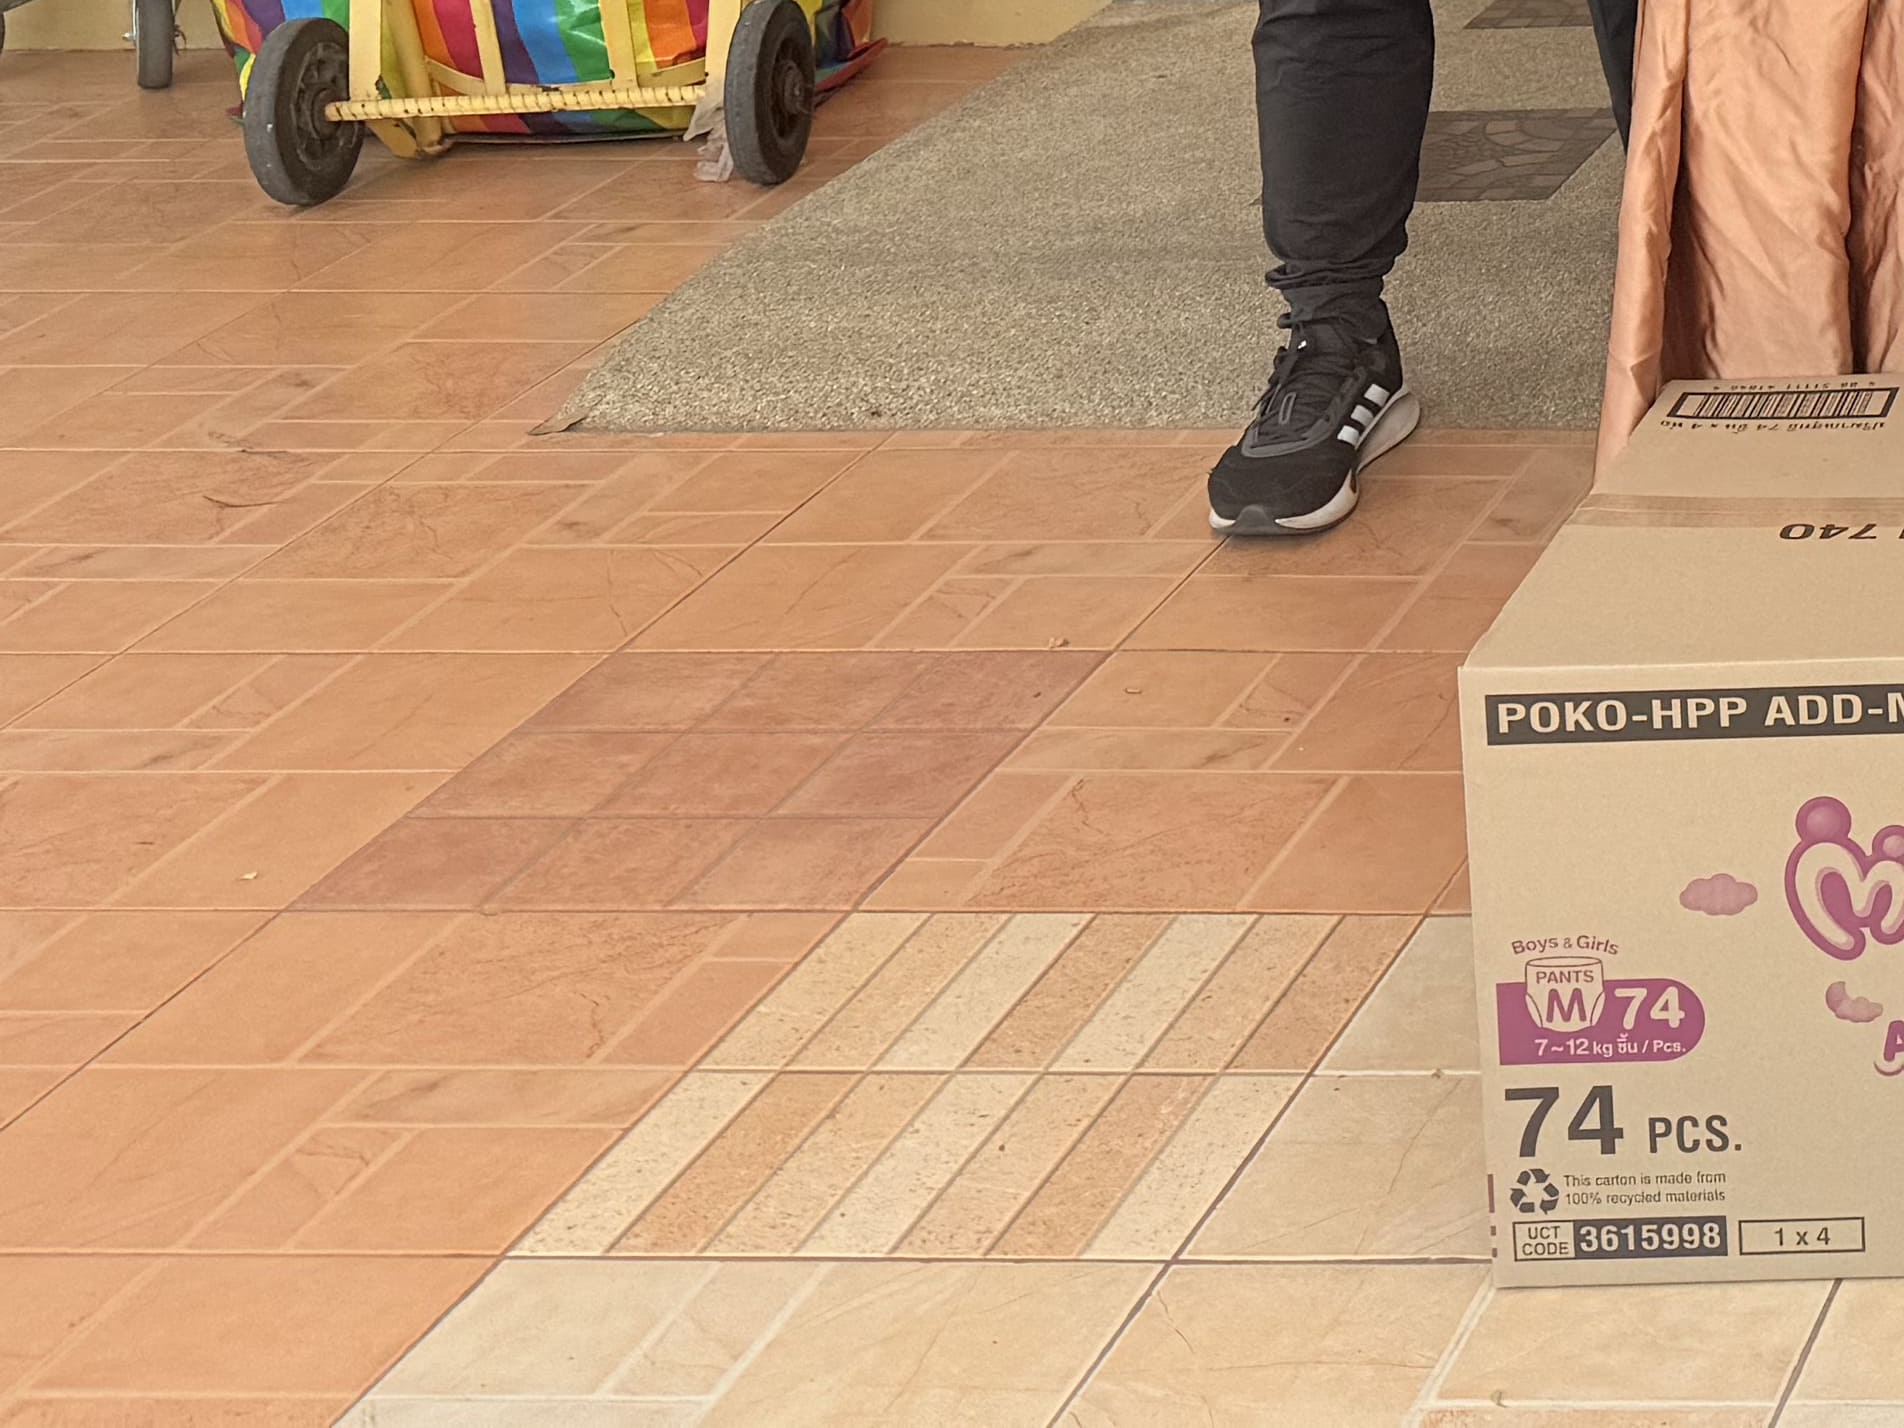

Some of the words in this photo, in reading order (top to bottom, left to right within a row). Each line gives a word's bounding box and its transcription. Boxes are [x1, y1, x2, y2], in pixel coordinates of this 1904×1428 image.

[1496, 696, 1747, 736] POKO-HPP
[1536, 970, 1594, 985] PANTS
[1546, 988, 1587, 1023] M
[1614, 986, 1685, 1030] 74
[1505, 1085, 1624, 1158] 74
[1649, 1115, 1742, 1153] PCS.
[1522, 1242, 1569, 1256] CODE
